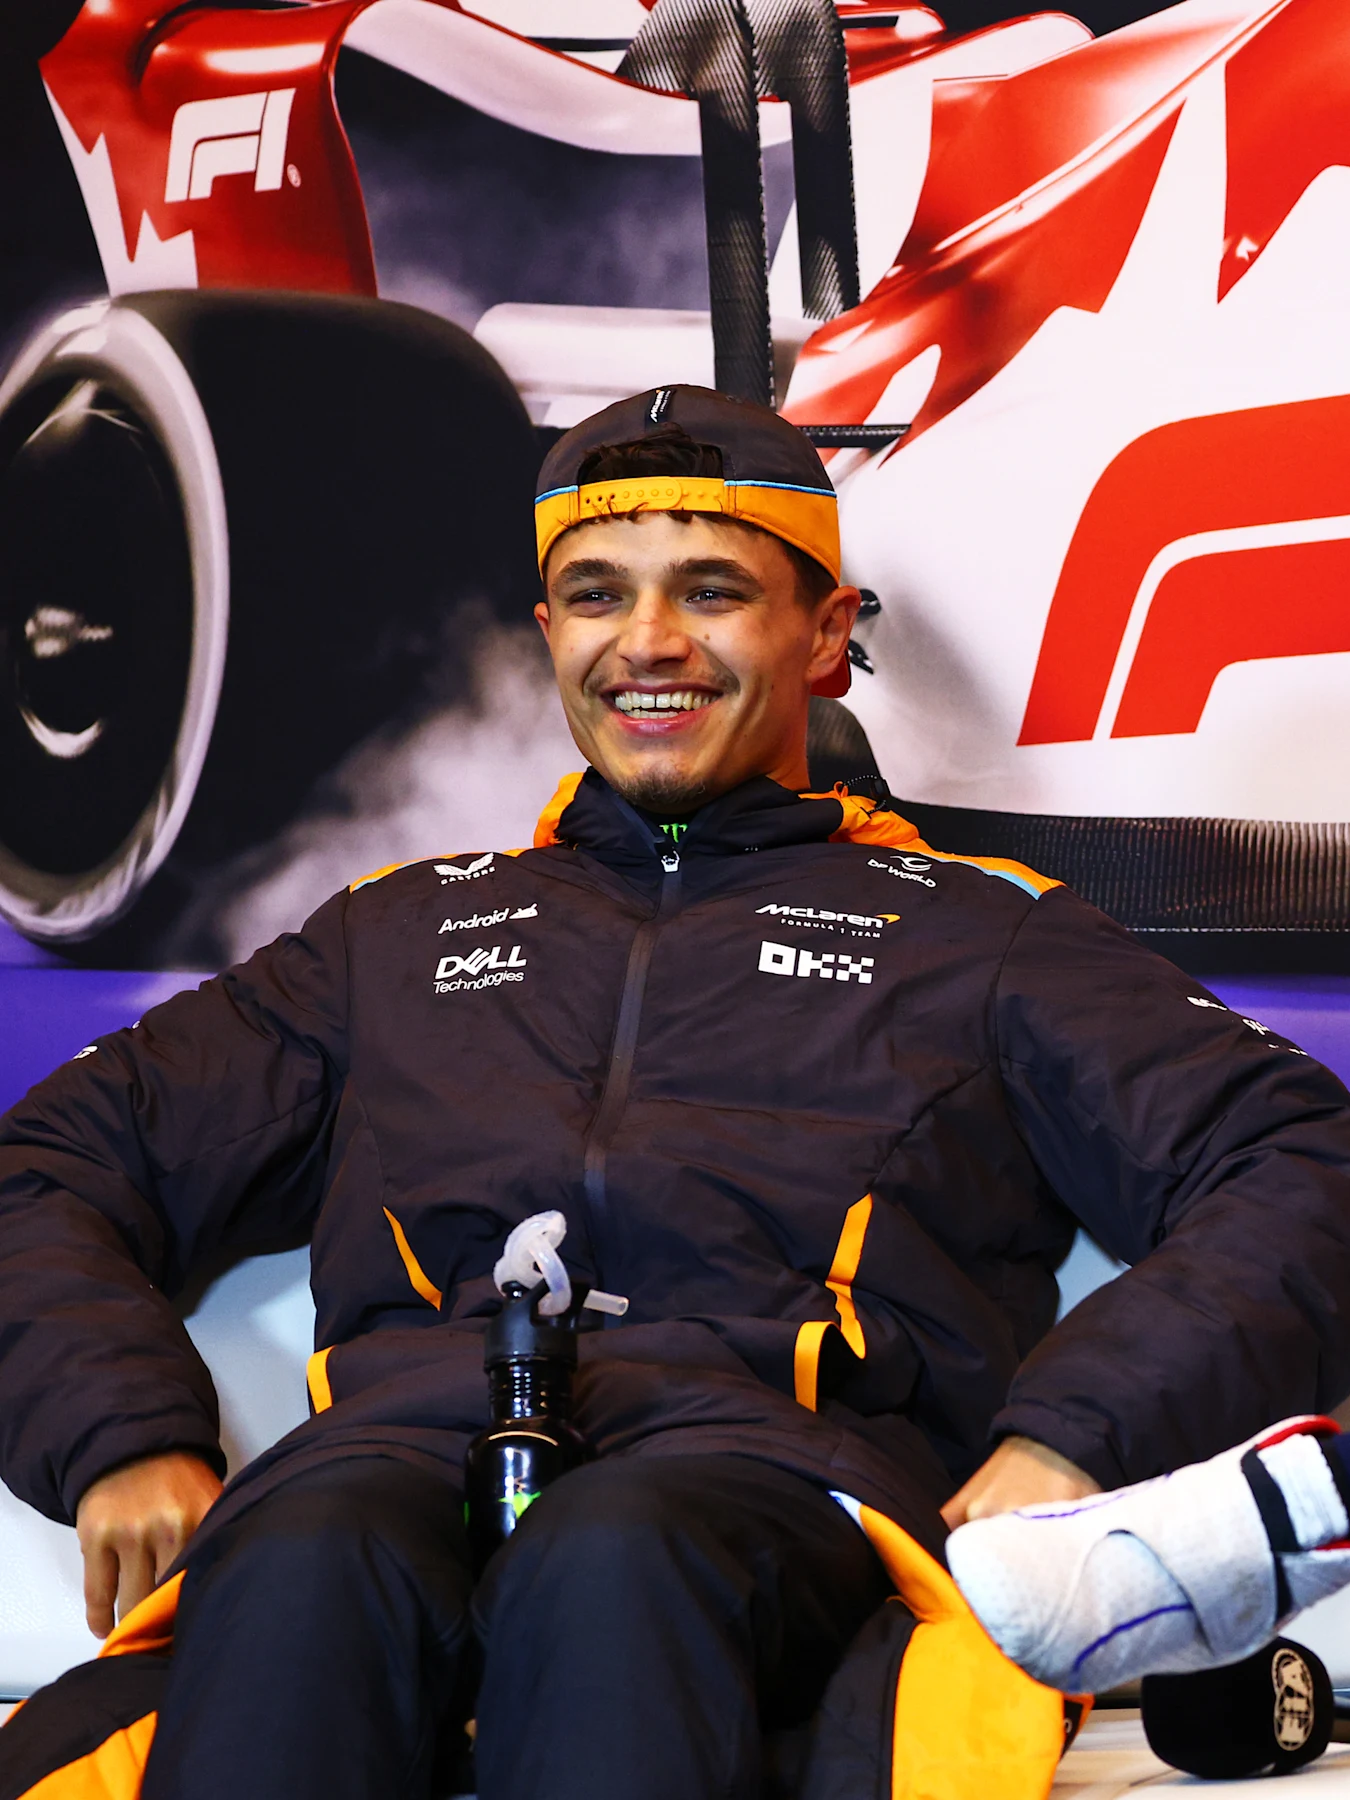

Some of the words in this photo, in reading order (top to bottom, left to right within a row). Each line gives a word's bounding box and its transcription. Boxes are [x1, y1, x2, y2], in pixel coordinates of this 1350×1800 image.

[164, 87, 296, 204] F1
[888, 866, 937, 888] WORLD
[437, 907, 510, 934] Android
[755, 903, 884, 929] McLaren
[781, 918, 835, 931] FORMULA
[851, 930, 881, 938] TEAM
[434, 945, 527, 980] DELL
[758, 940, 875, 984] OKX
[433, 970, 525, 994] Technologies
